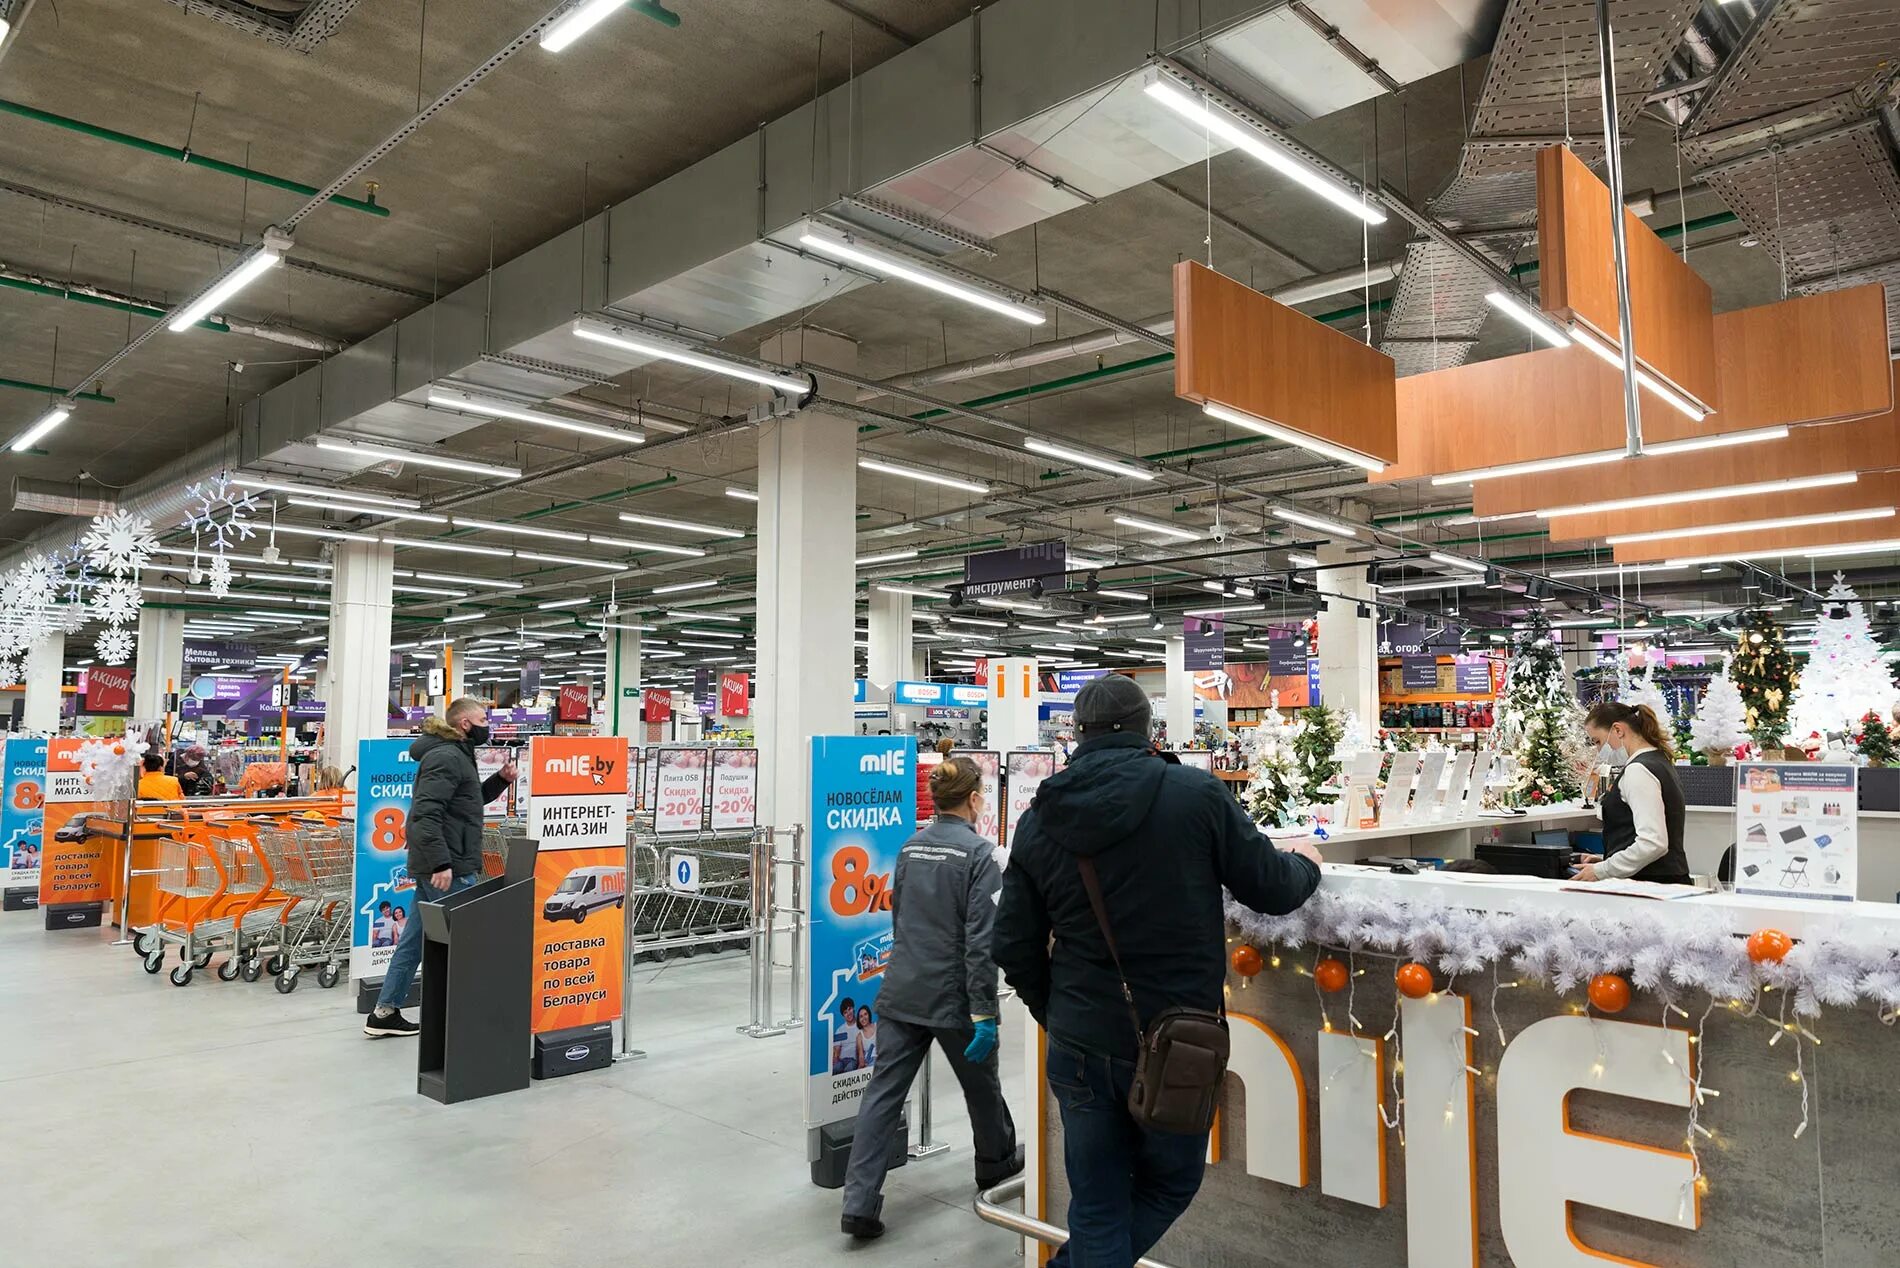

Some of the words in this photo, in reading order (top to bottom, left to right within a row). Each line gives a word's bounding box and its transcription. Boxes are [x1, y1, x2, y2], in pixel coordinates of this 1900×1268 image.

[185, 648, 218, 657] Мелкая
[184, 656, 219, 664] бытовая
[222, 658, 255, 666] техника
[90, 671, 129, 690] АКЦИЯ
[722, 677, 744, 695] АКЦИЯ
[563, 688, 588, 704] АКЦИЯ
[648, 691, 670, 706] АКЦИЯ
[663, 774, 684, 782] Плита
[720, 773, 749, 782] Подушки
[370, 784, 413, 798] СКИД
[664, 787, 697, 797] Скидка
[719, 785, 749, 796] Скидка
[827, 787, 903, 806] НОВОСЁЛАМ
[543, 805, 616, 820] ИНТЕРНЕТ-
[658, 797, 703, 817] -20%
[714, 796, 755, 814] -20%
[826, 806, 903, 831] СКИДКА
[542, 821, 608, 837] МАГАЗИН
[54, 852, 101, 861] доставка
[54, 863, 89, 871] товара
[69, 872, 92, 880] всей
[53, 882, 101, 891] Беларуси
[543, 936, 606, 955] доставка
[543, 956, 590, 971] товара
[543, 978, 560, 990] по
[564, 970, 596, 987] всей
[543, 989, 607, 1009] Беларуси
[832, 1075, 861, 1090] СКИДКА
[861, 1072, 872, 1082] ПО
